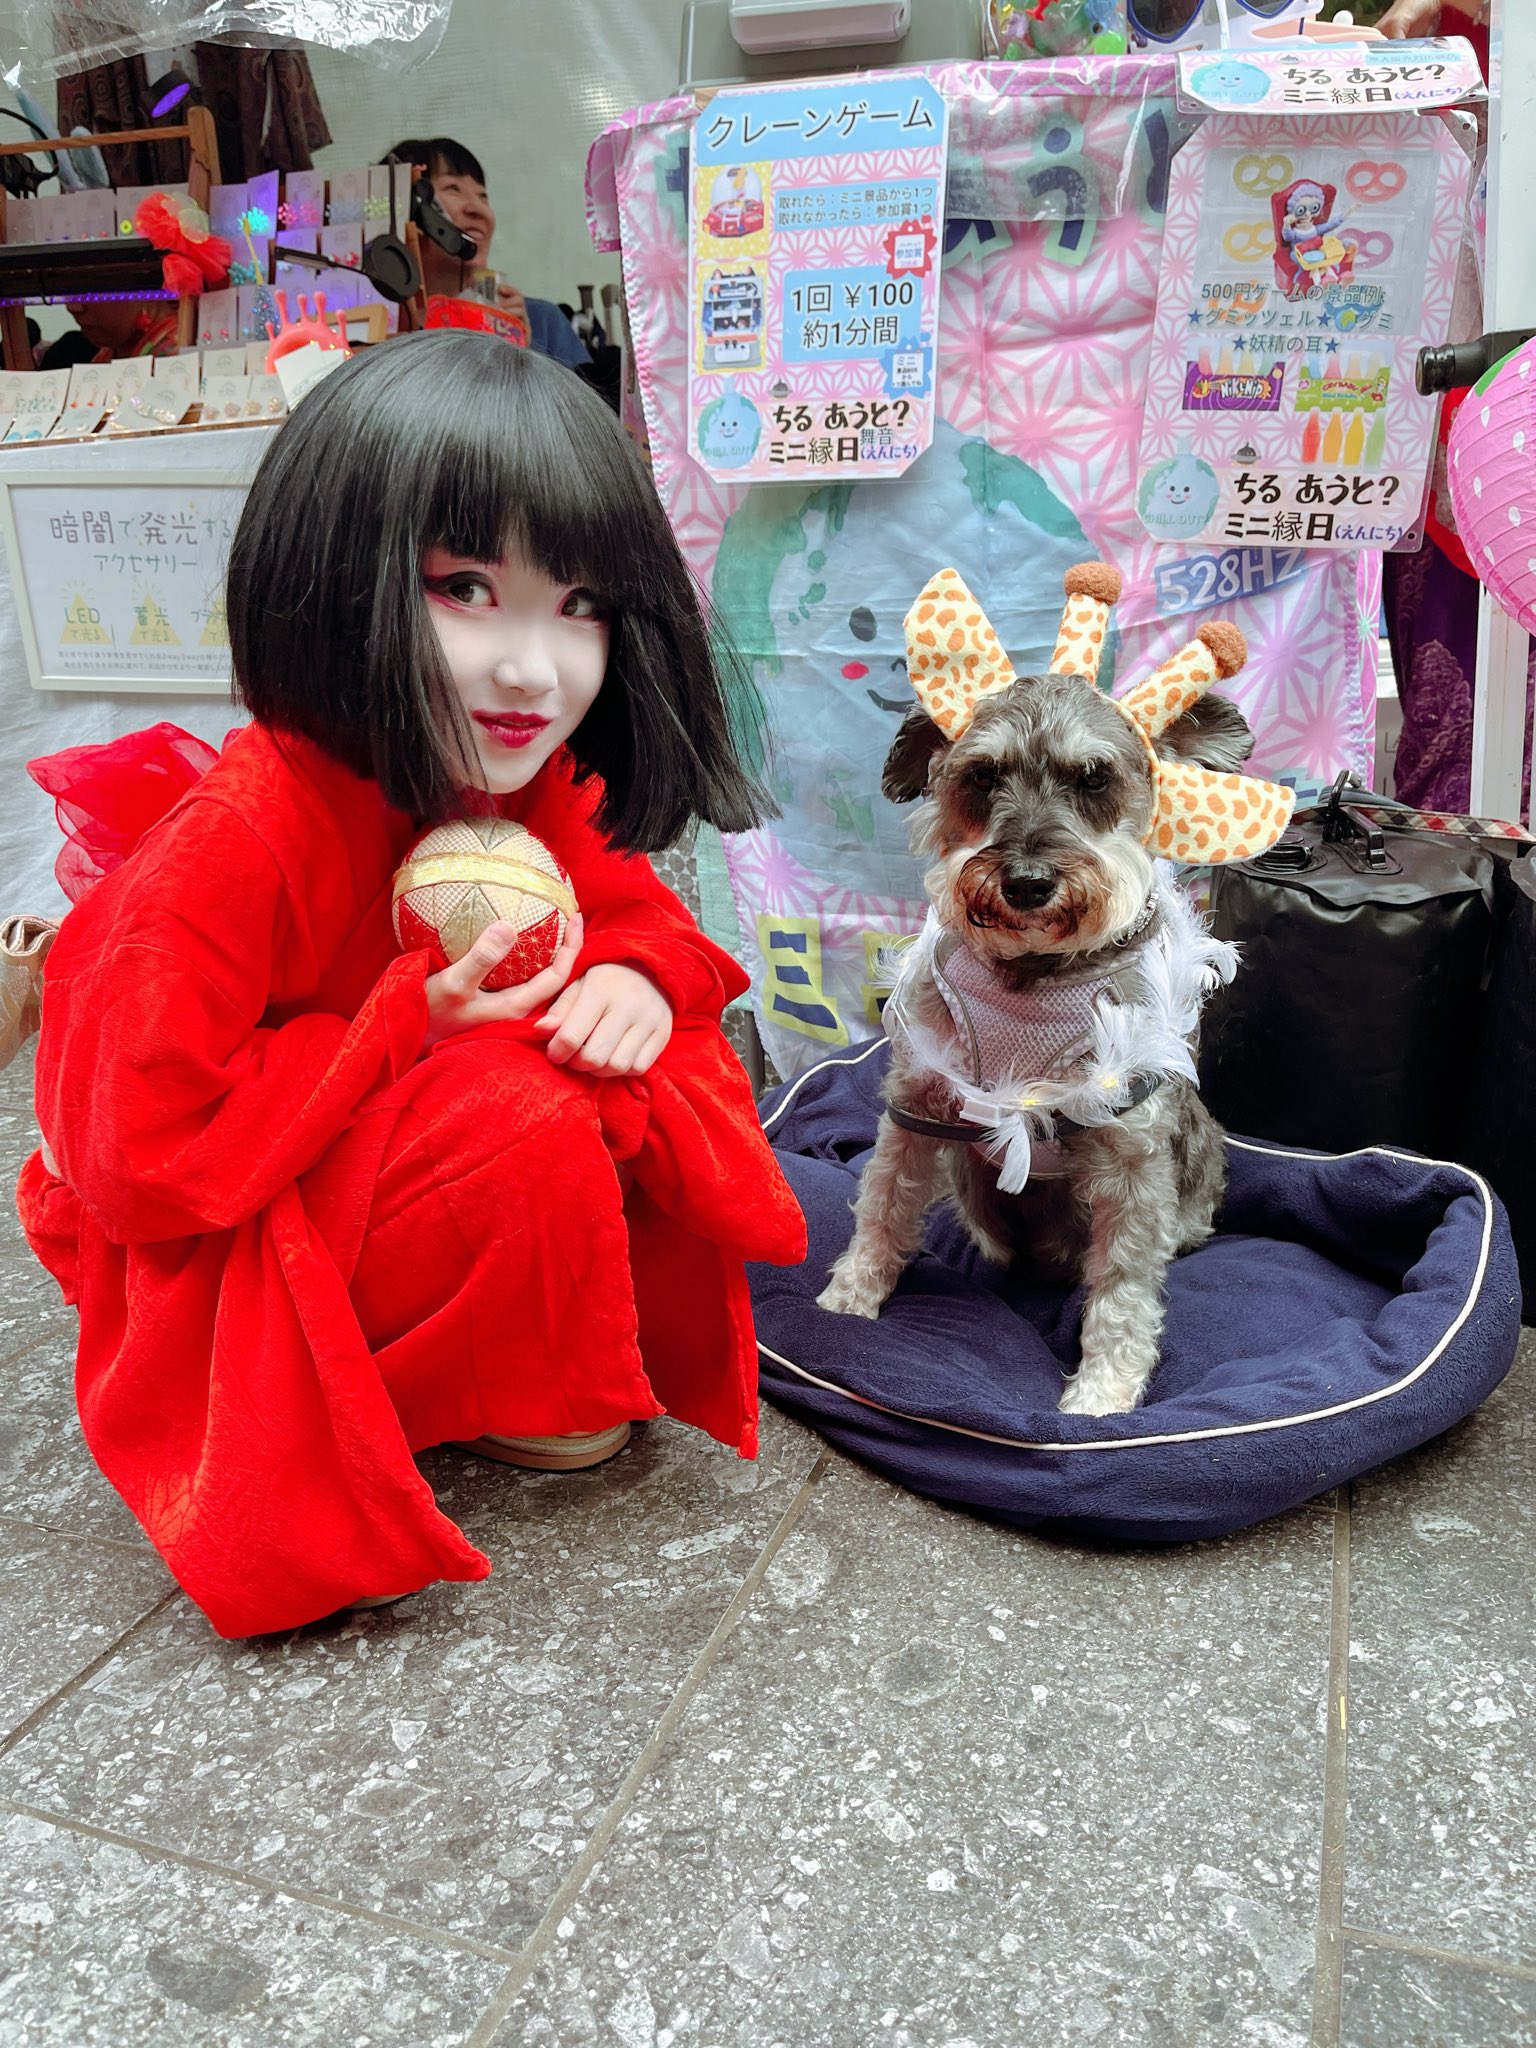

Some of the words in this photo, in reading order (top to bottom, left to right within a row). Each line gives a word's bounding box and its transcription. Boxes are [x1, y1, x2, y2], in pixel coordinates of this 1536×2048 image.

[1283, 68, 1333, 85] ちる
[1345, 64, 1446, 83] あうと?
[1283, 87, 1393, 105] ミニ縁日
[1394, 87, 1464, 100] (えんにち)
[706, 98, 934, 148] クレーンゲーム
[792, 284, 832, 313] 1回
[1205, 309, 1315, 327] グミッツェル
[803, 315, 898, 348] 約1分間
[1248, 334, 1323, 353] 妖精の耳
[773, 404, 813, 434] ちる
[824, 400, 910, 430] あうと?
[860, 427, 893, 446] 舞音
[769, 437, 858, 464] ミニ縁日
[860, 446, 918, 461] (えんにち)
[1233, 473, 1281, 504] ちる
[1295, 474, 1400, 505] あうと?
[50, 511, 232, 545] 暗闇で発光する
[1224, 511, 1335, 542] ミニ縁日
[1335, 525, 1403, 541] (えんにち)
[93, 554, 198, 574] アクセサリー
[64, 607, 101, 625] LED
[134, 606, 170, 627] 蓄光
